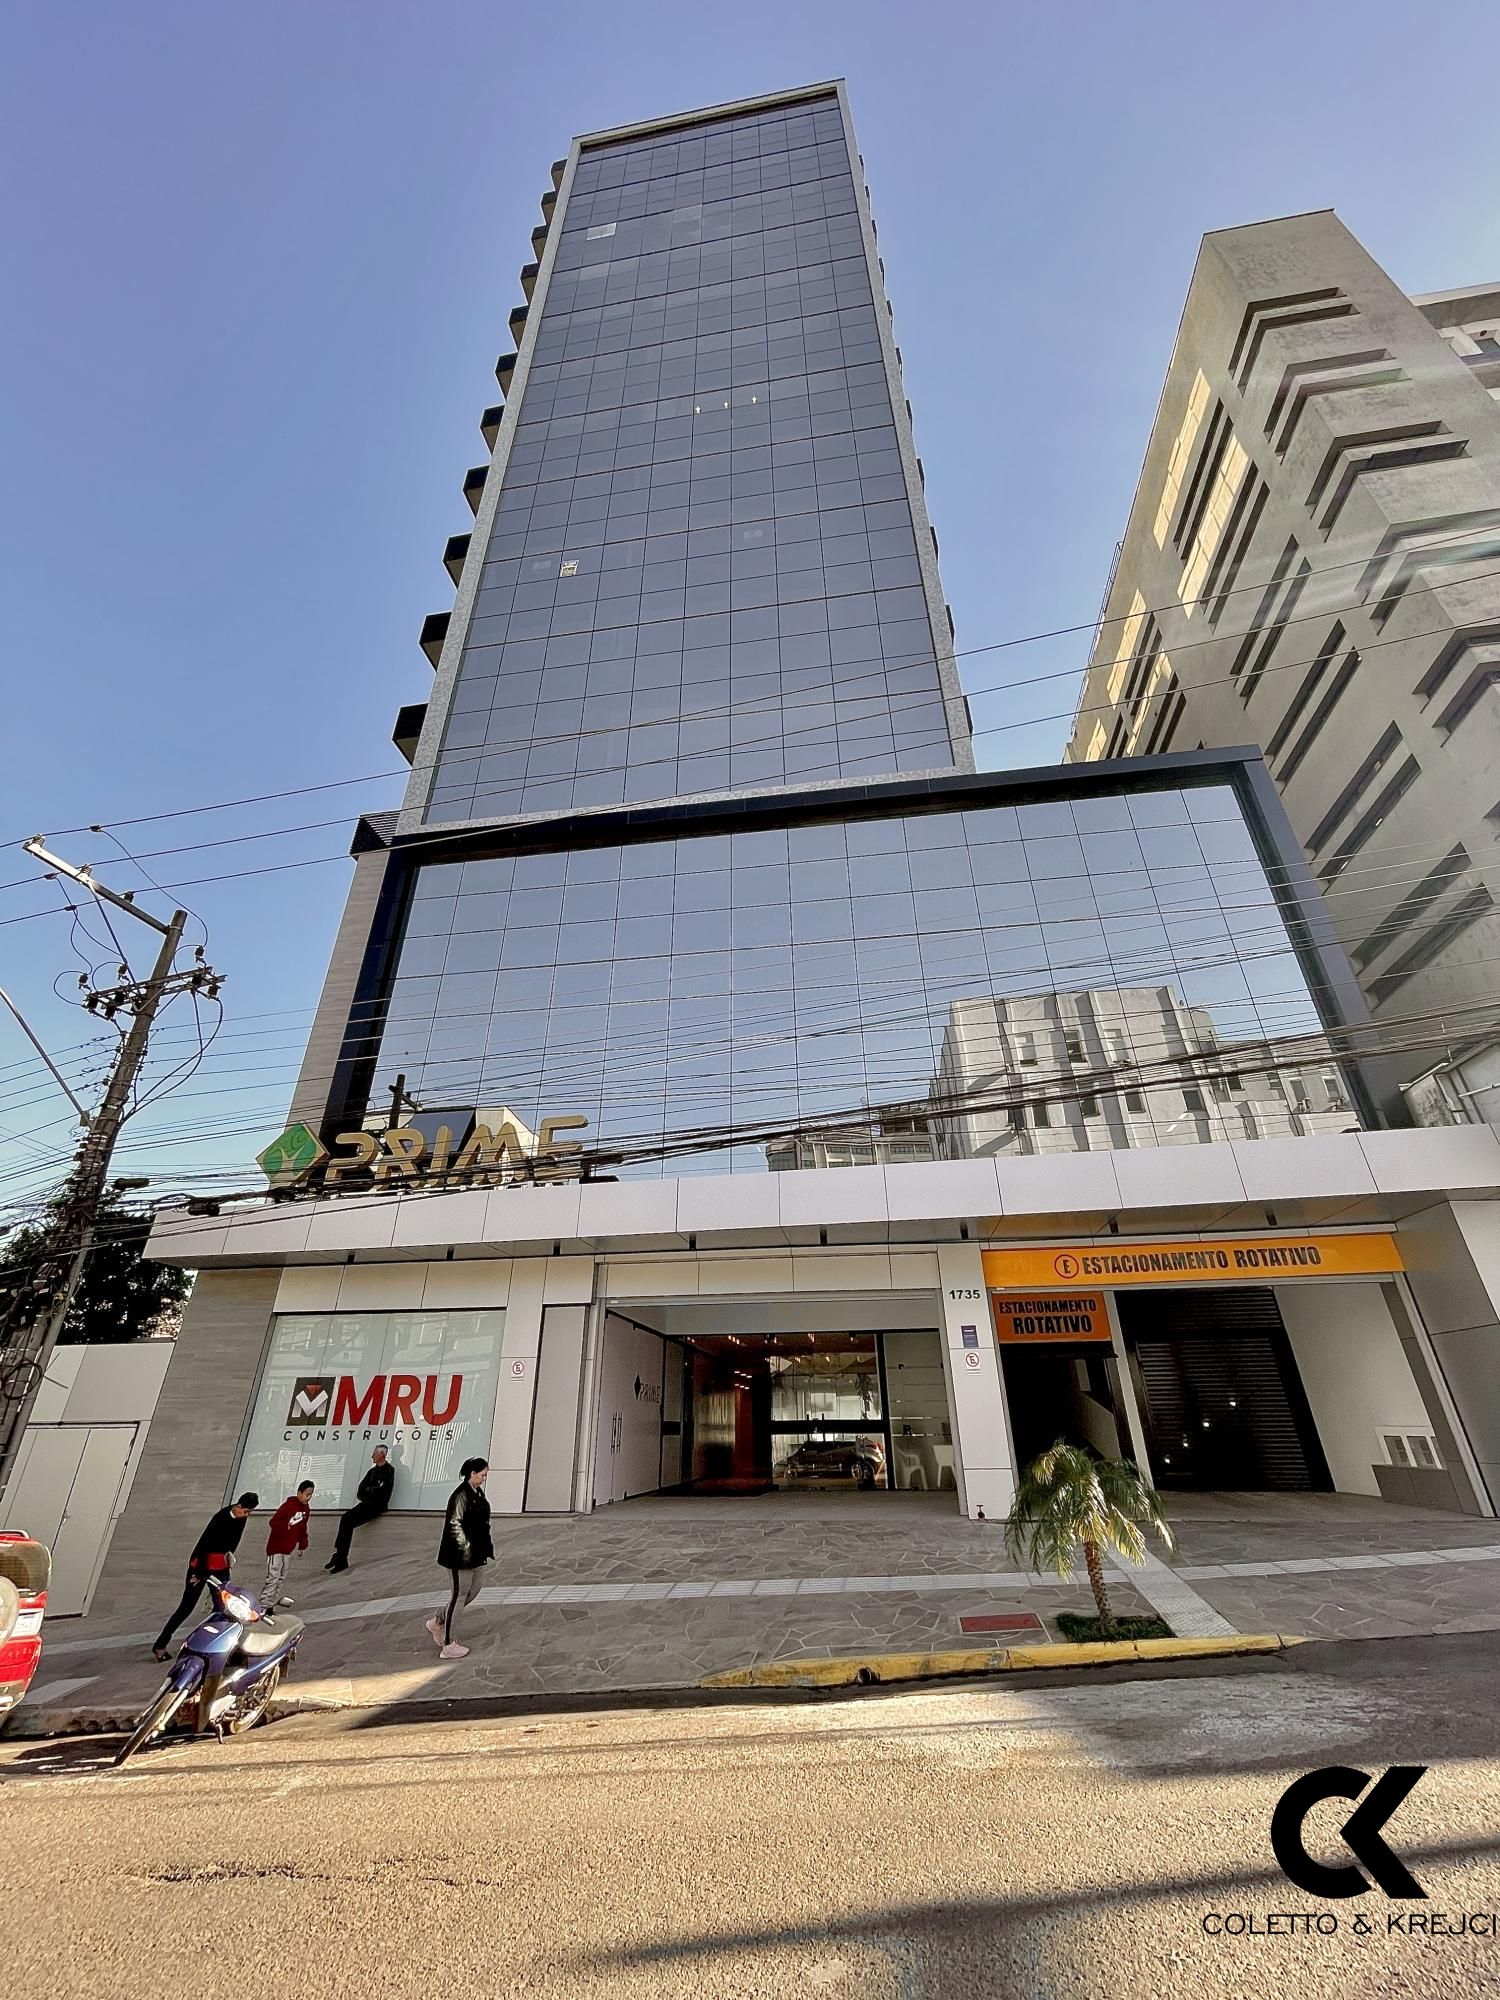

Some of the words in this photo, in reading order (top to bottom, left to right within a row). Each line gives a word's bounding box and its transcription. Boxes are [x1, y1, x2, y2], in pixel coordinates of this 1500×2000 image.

[323, 1114, 589, 1190] PRIME
[1081, 1250, 1229, 1275] ESTACIONAMENTO
[1235, 1246, 1322, 1268] ROTATIVO
[949, 1289, 981, 1300] 1735
[998, 1299, 1097, 1314] ESTACIONAMENTO
[1013, 1314, 1093, 1334] ROTATIVO
[331, 1374, 464, 1426] MRU
[283, 1427, 454, 1444] CONSTRUÇÕES
